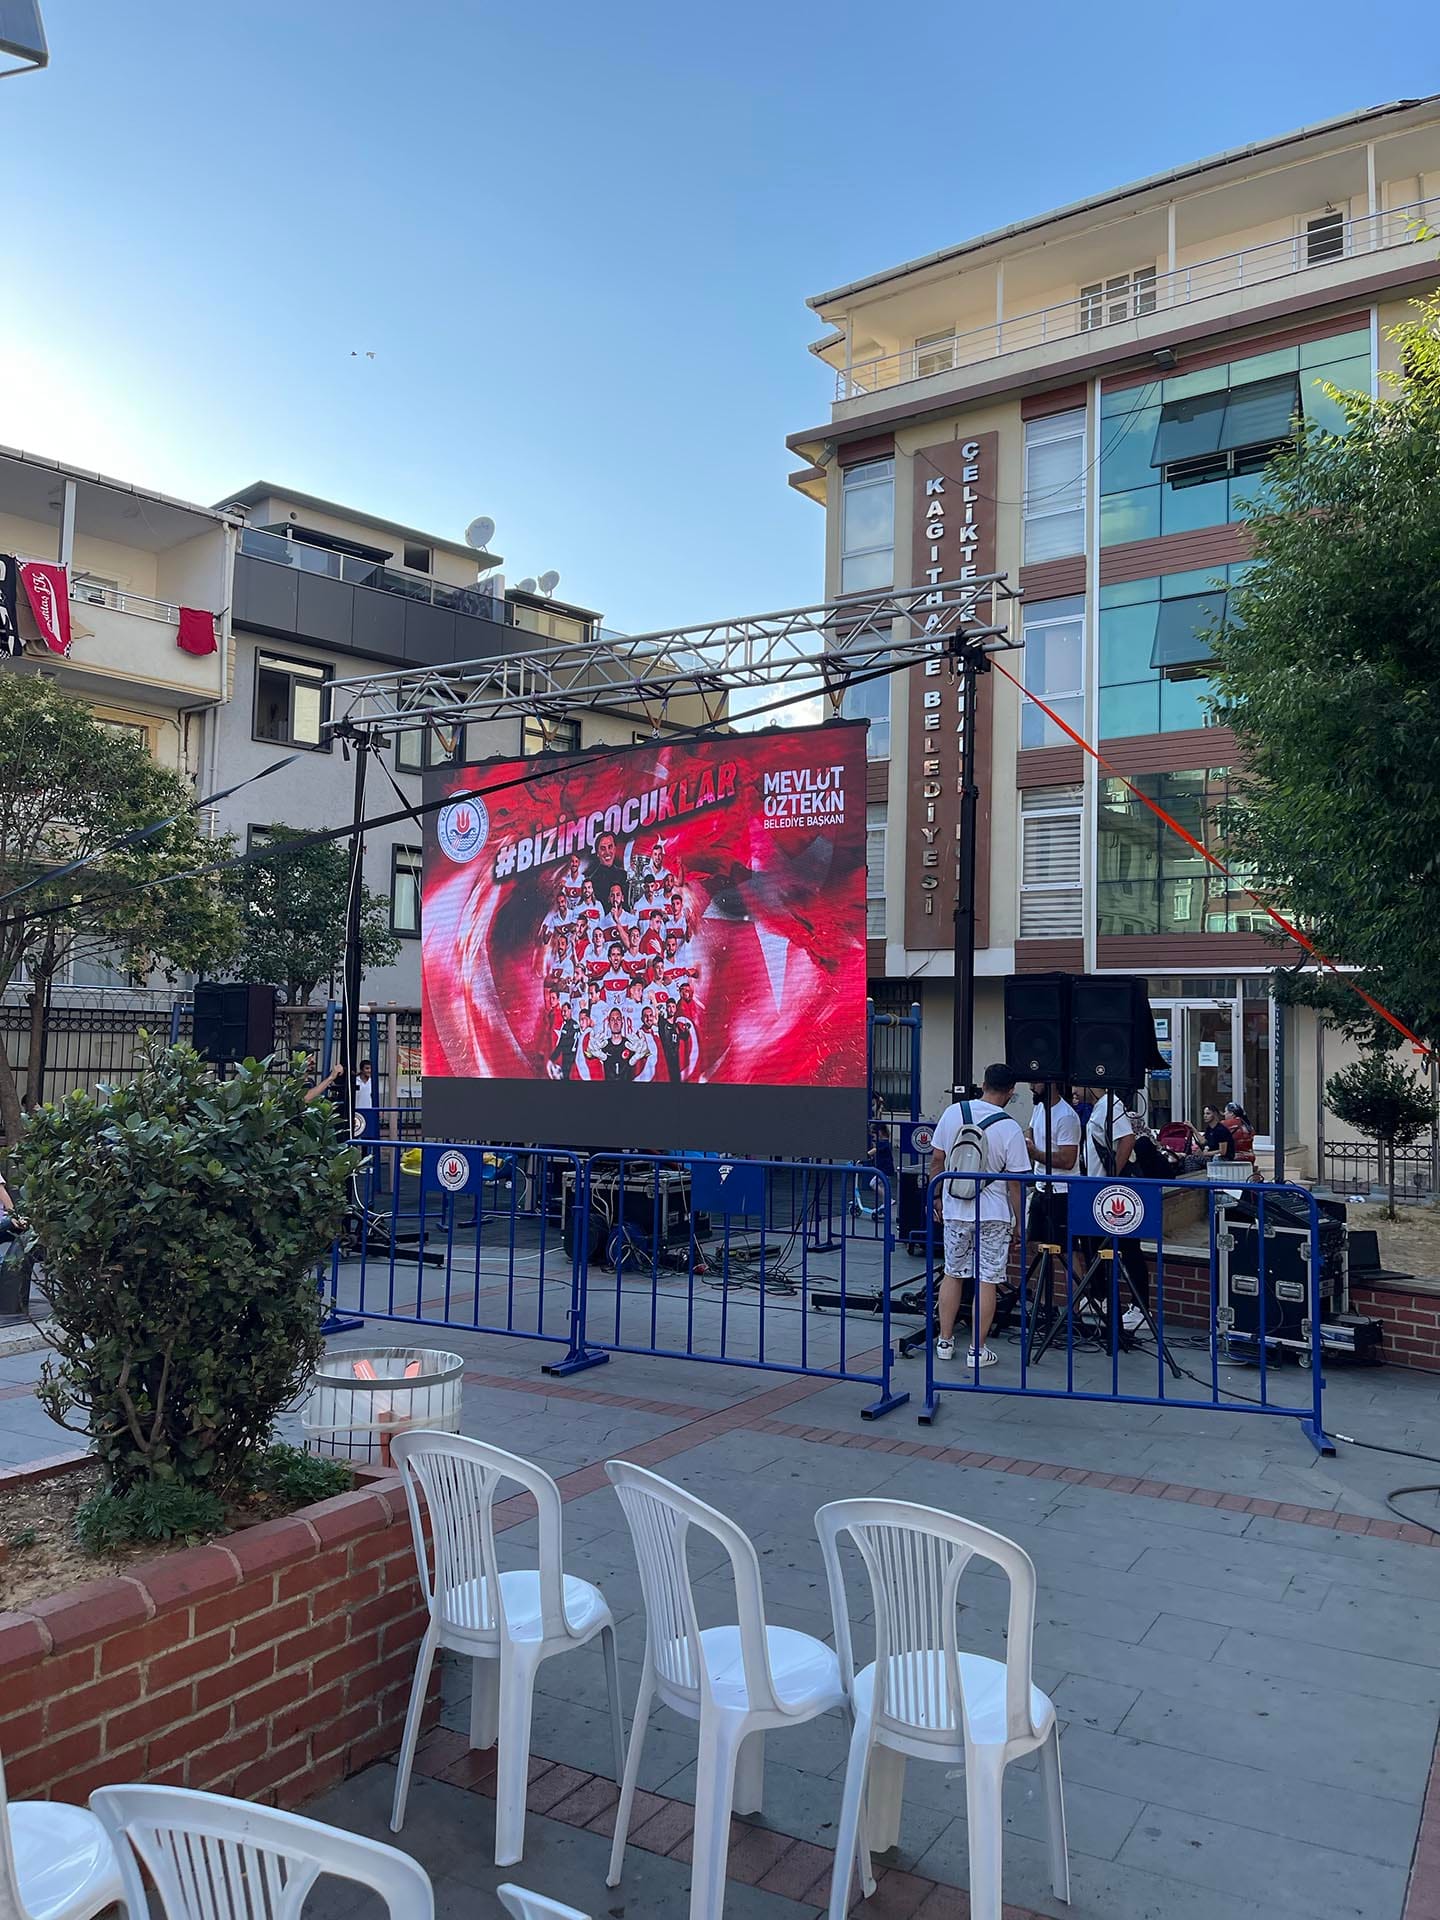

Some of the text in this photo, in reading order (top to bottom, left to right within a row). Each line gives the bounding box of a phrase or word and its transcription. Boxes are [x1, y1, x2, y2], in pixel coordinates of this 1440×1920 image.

[764, 766, 844, 794] MEVLÜT
[921, 691, 942, 915] BELEDİYESİ
[495, 762, 738, 879] #BİZİMÇOCUKLAR
[764, 814, 844, 830] BELEDİYE BAŞKANI
